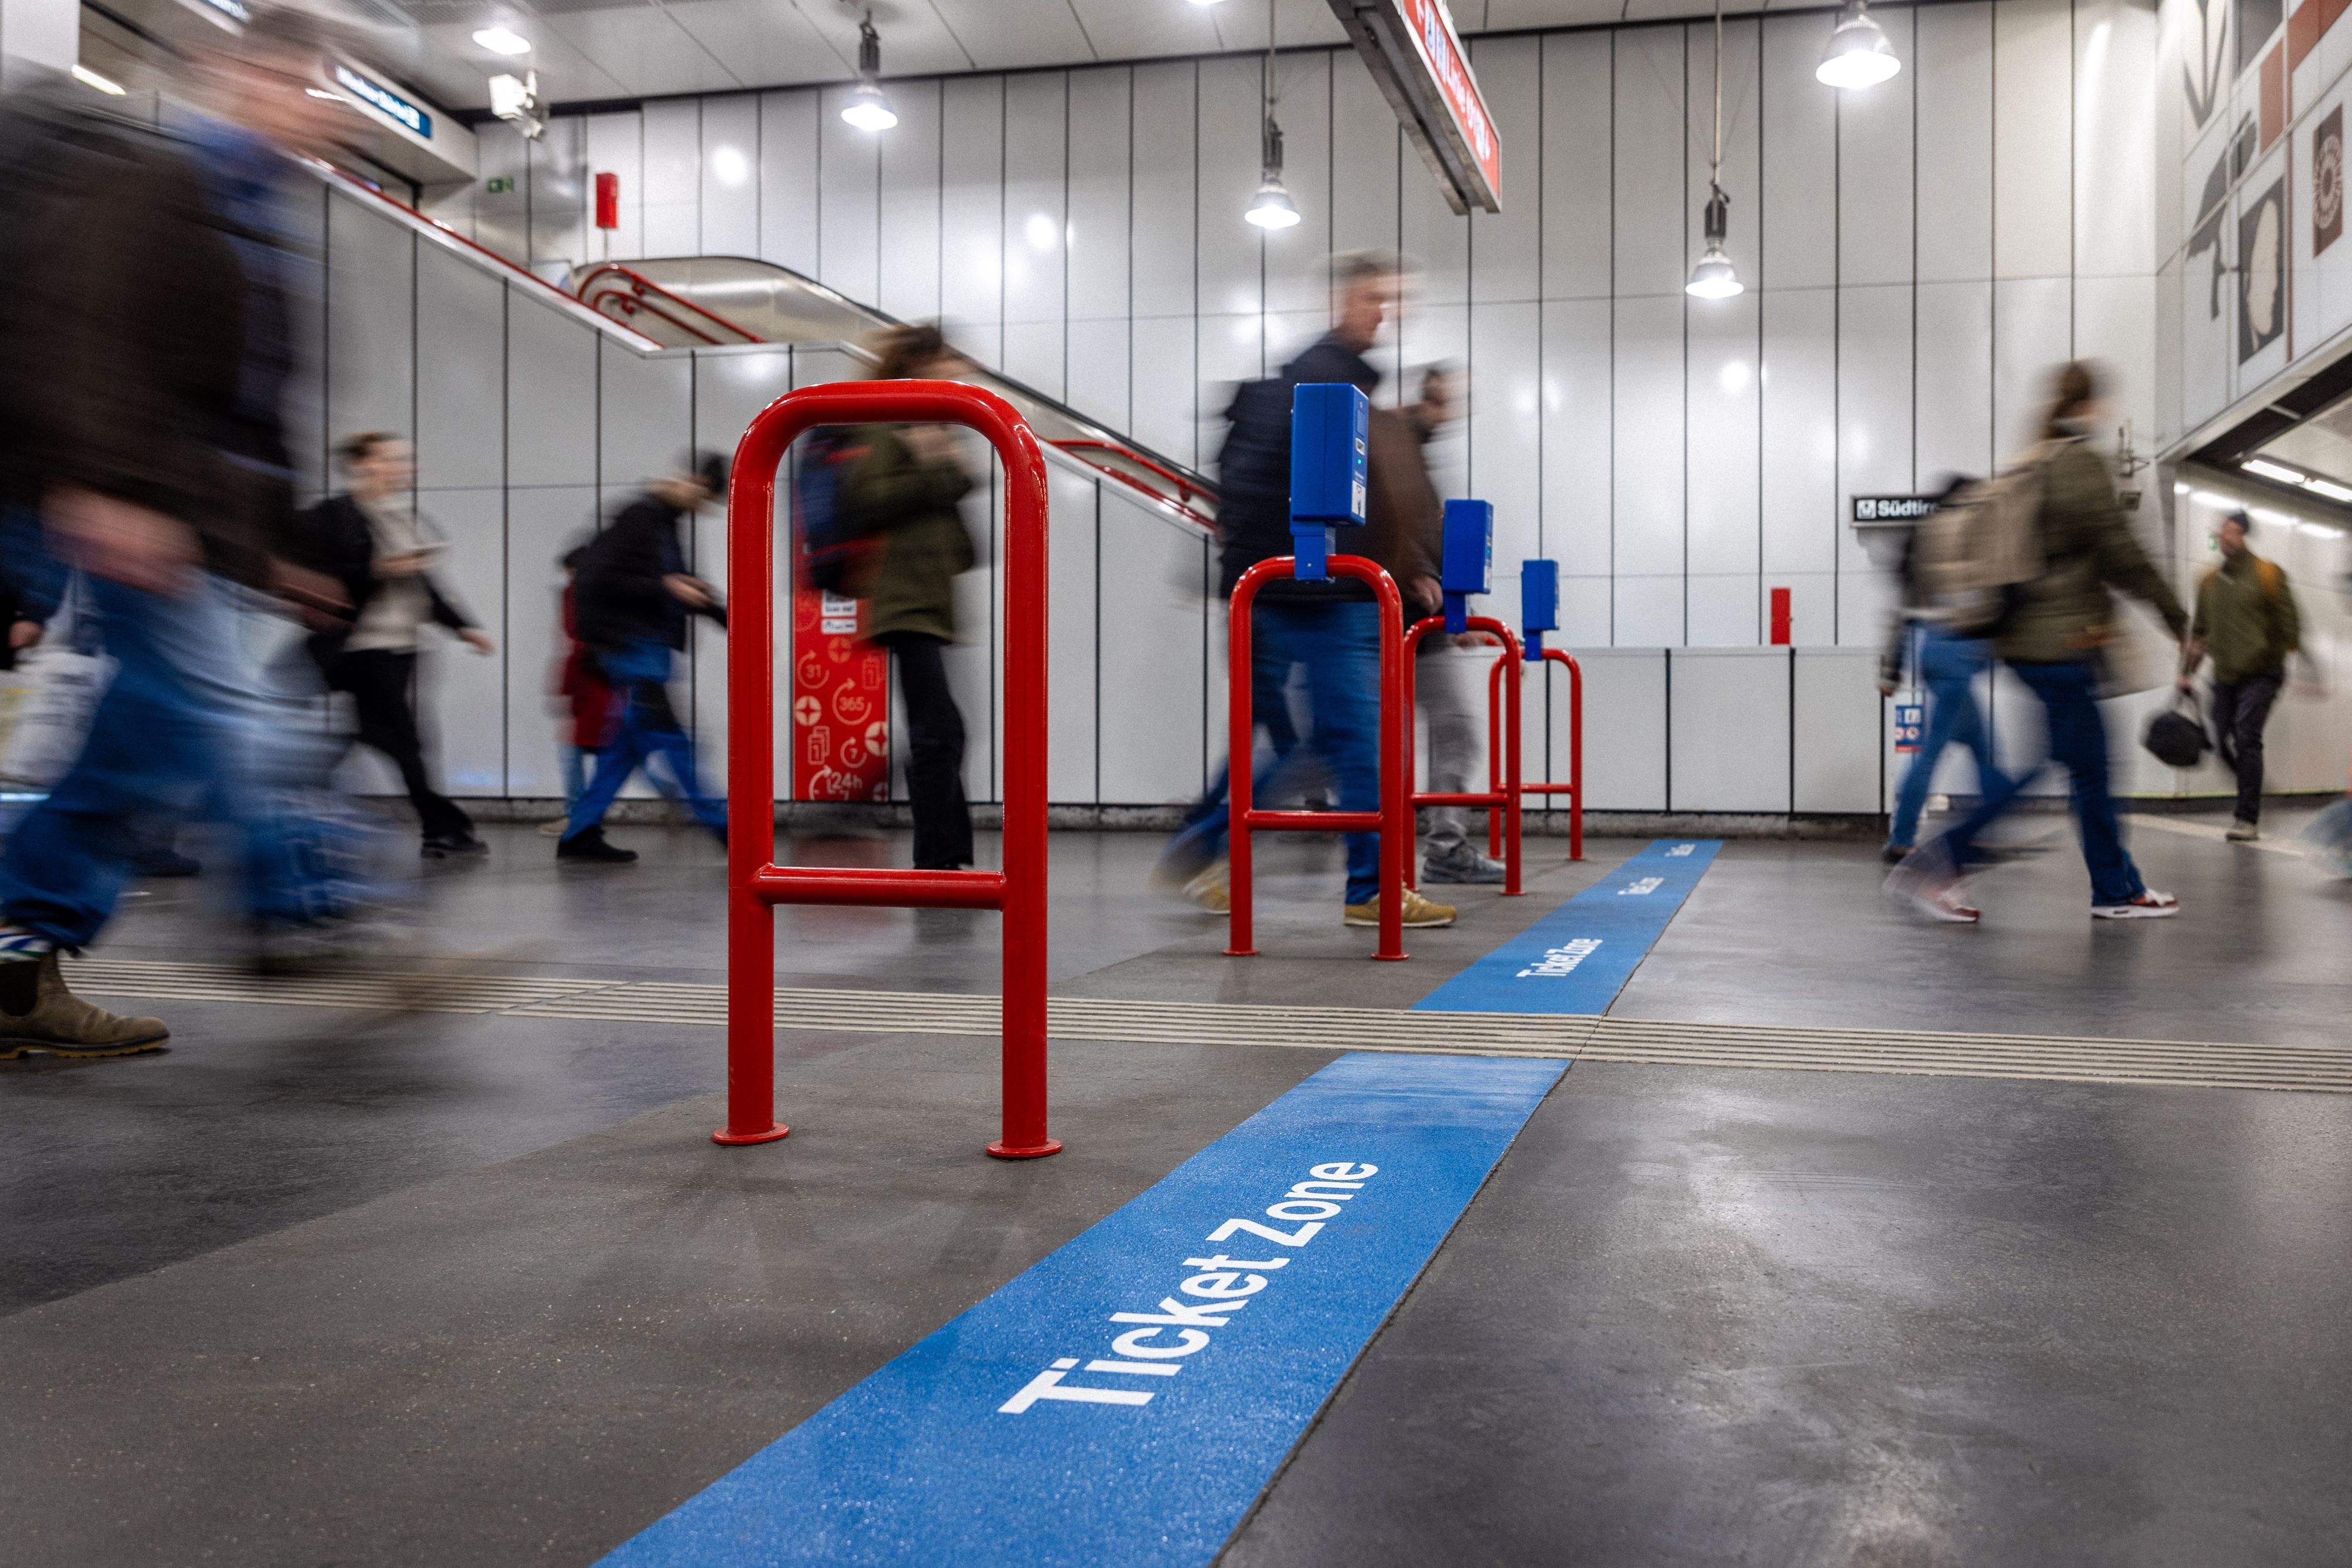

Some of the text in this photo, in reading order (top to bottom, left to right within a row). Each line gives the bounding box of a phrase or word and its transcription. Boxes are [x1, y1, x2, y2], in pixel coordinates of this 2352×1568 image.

[806, 664, 821, 678] 31
[839, 696, 865, 711] 365
[812, 744, 820, 760] 1
[850, 747, 858, 760] 7
[831, 771, 863, 789] 24h
[998, 1162, 1378, 1414] Ticket Zone
